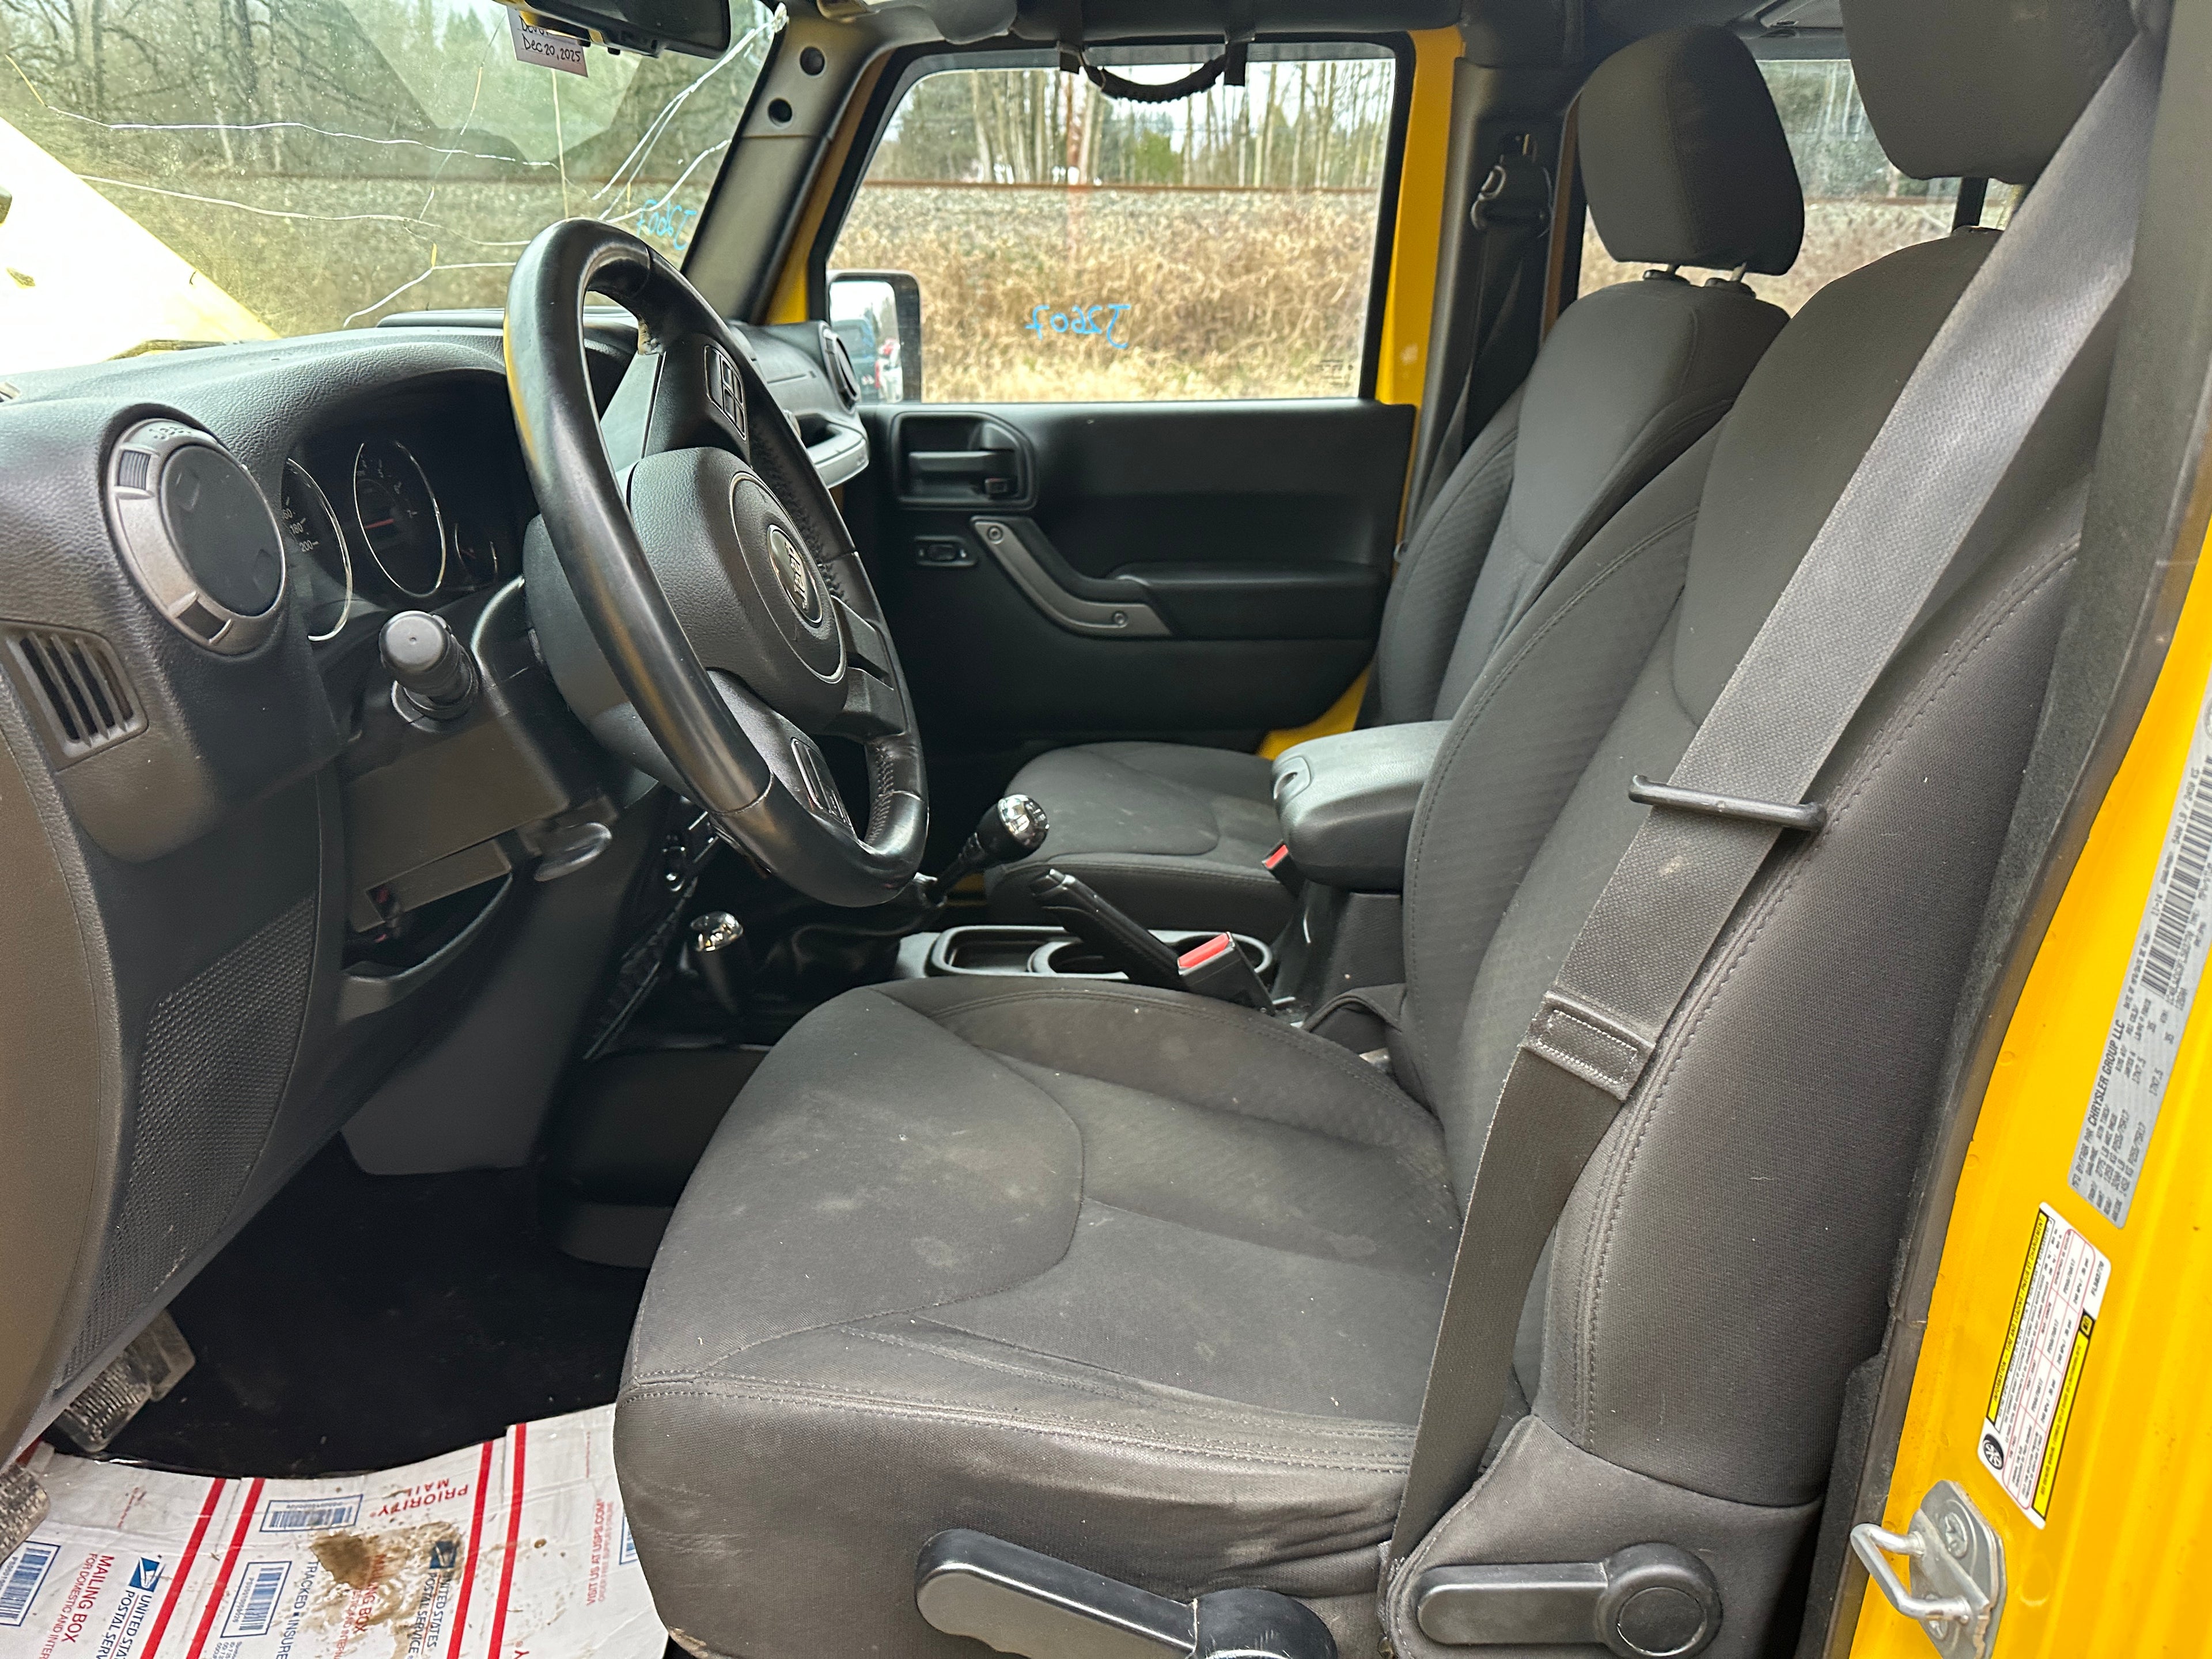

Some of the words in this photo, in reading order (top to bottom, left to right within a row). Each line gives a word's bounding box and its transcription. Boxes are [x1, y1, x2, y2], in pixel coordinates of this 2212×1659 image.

[521, 33, 543, 52] Dec
[281, 508, 293, 520] 60
[290, 522, 304, 535] 180
[300, 540, 313, 552] 200
[2086, 1073, 2109, 1128] CHRYSLER
[2101, 1037, 2119, 1077] GROUP
[2111, 1017, 2125, 1041] LLC
[1993, 1359, 2006, 1402] INFORMATION
[2013, 1294, 2023, 1324] LOADING
[2029, 1217, 2043, 1261] CHARGEMENT
[404, 1478, 450, 1498] MAIL
[83, 1552, 98, 1571] FOR
[62, 1570, 90, 1613] DOMESTIC
[78, 1555, 115, 1609] MAILING
[294, 1561, 319, 1609] TRACKED
[420, 1572, 438, 1611] POSTAL
[53, 1614, 69, 1633] AND
[62, 1613, 88, 1643] BOX
[108, 1590, 135, 1630] POSTAL
[126, 1594, 152, 1637] UNITED
[353, 1606, 372, 1634] BOX
[427, 1610, 444, 1648] STATES
[408, 1611, 428, 1654] SERVICE
